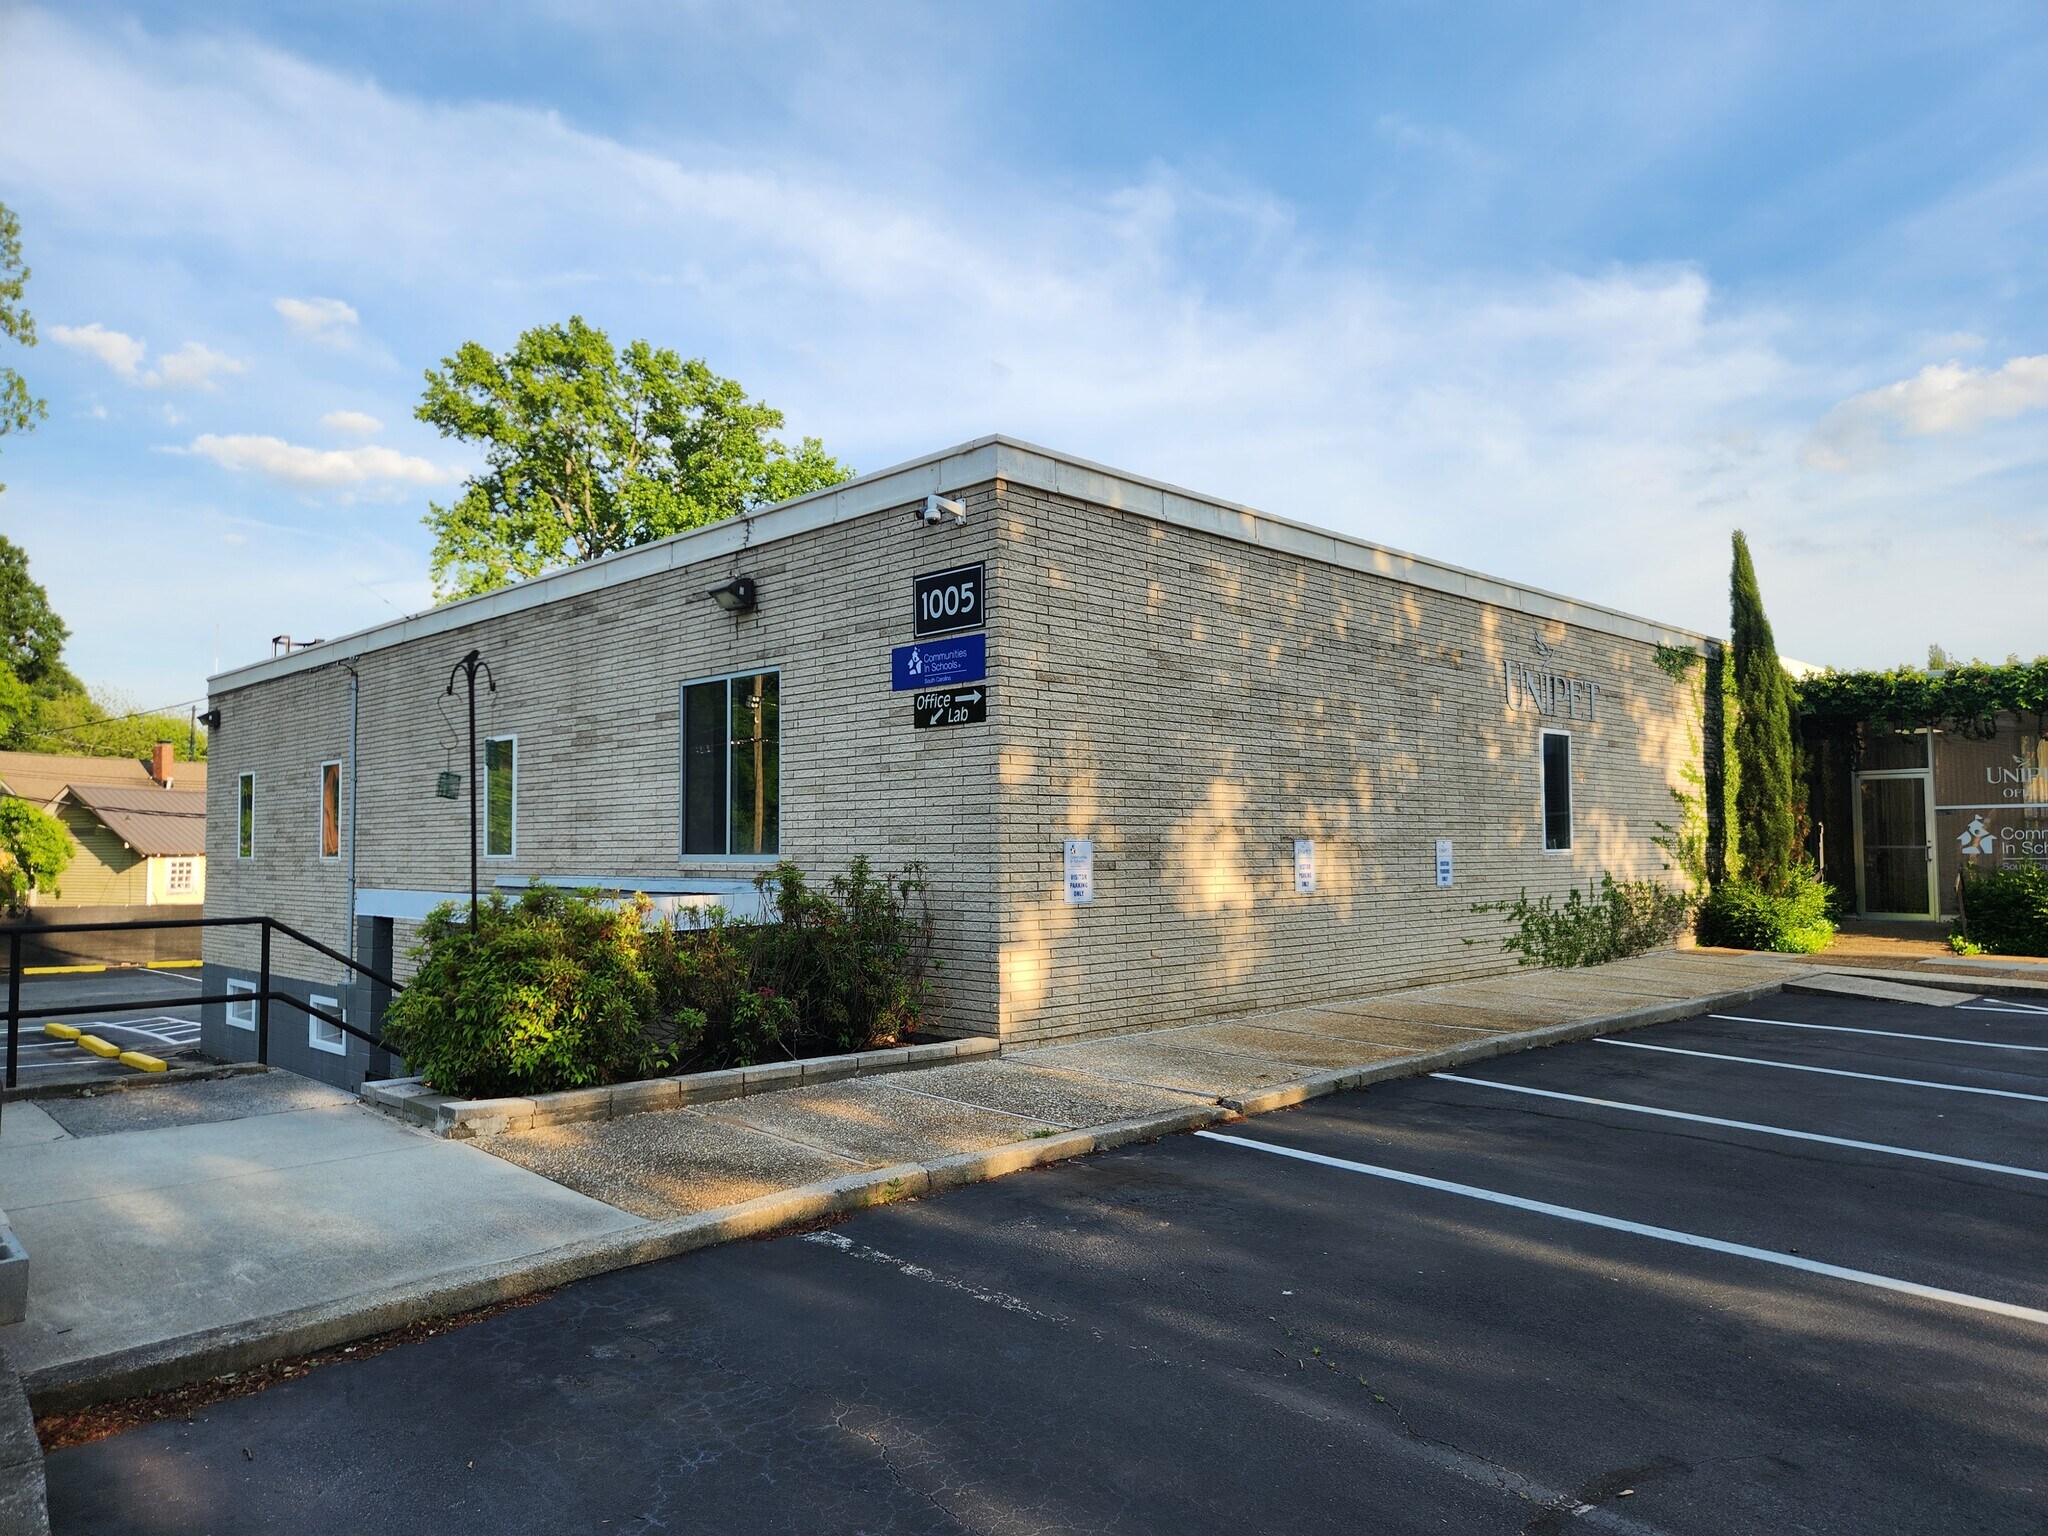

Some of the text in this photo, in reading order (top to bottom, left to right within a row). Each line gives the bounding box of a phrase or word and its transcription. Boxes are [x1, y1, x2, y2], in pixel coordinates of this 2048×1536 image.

[922, 582, 975, 620] 1005
[923, 649, 967, 663] Communities
[924, 664, 930, 673] In
[924, 675, 952, 685] South Carolina
[1503, 660, 1600, 721] UNIPET
[916, 693, 951, 710] Office
[947, 706, 969, 723] Lab
[1985, 766, 2048, 784] UNIP
[2002, 841, 2016, 854] In
